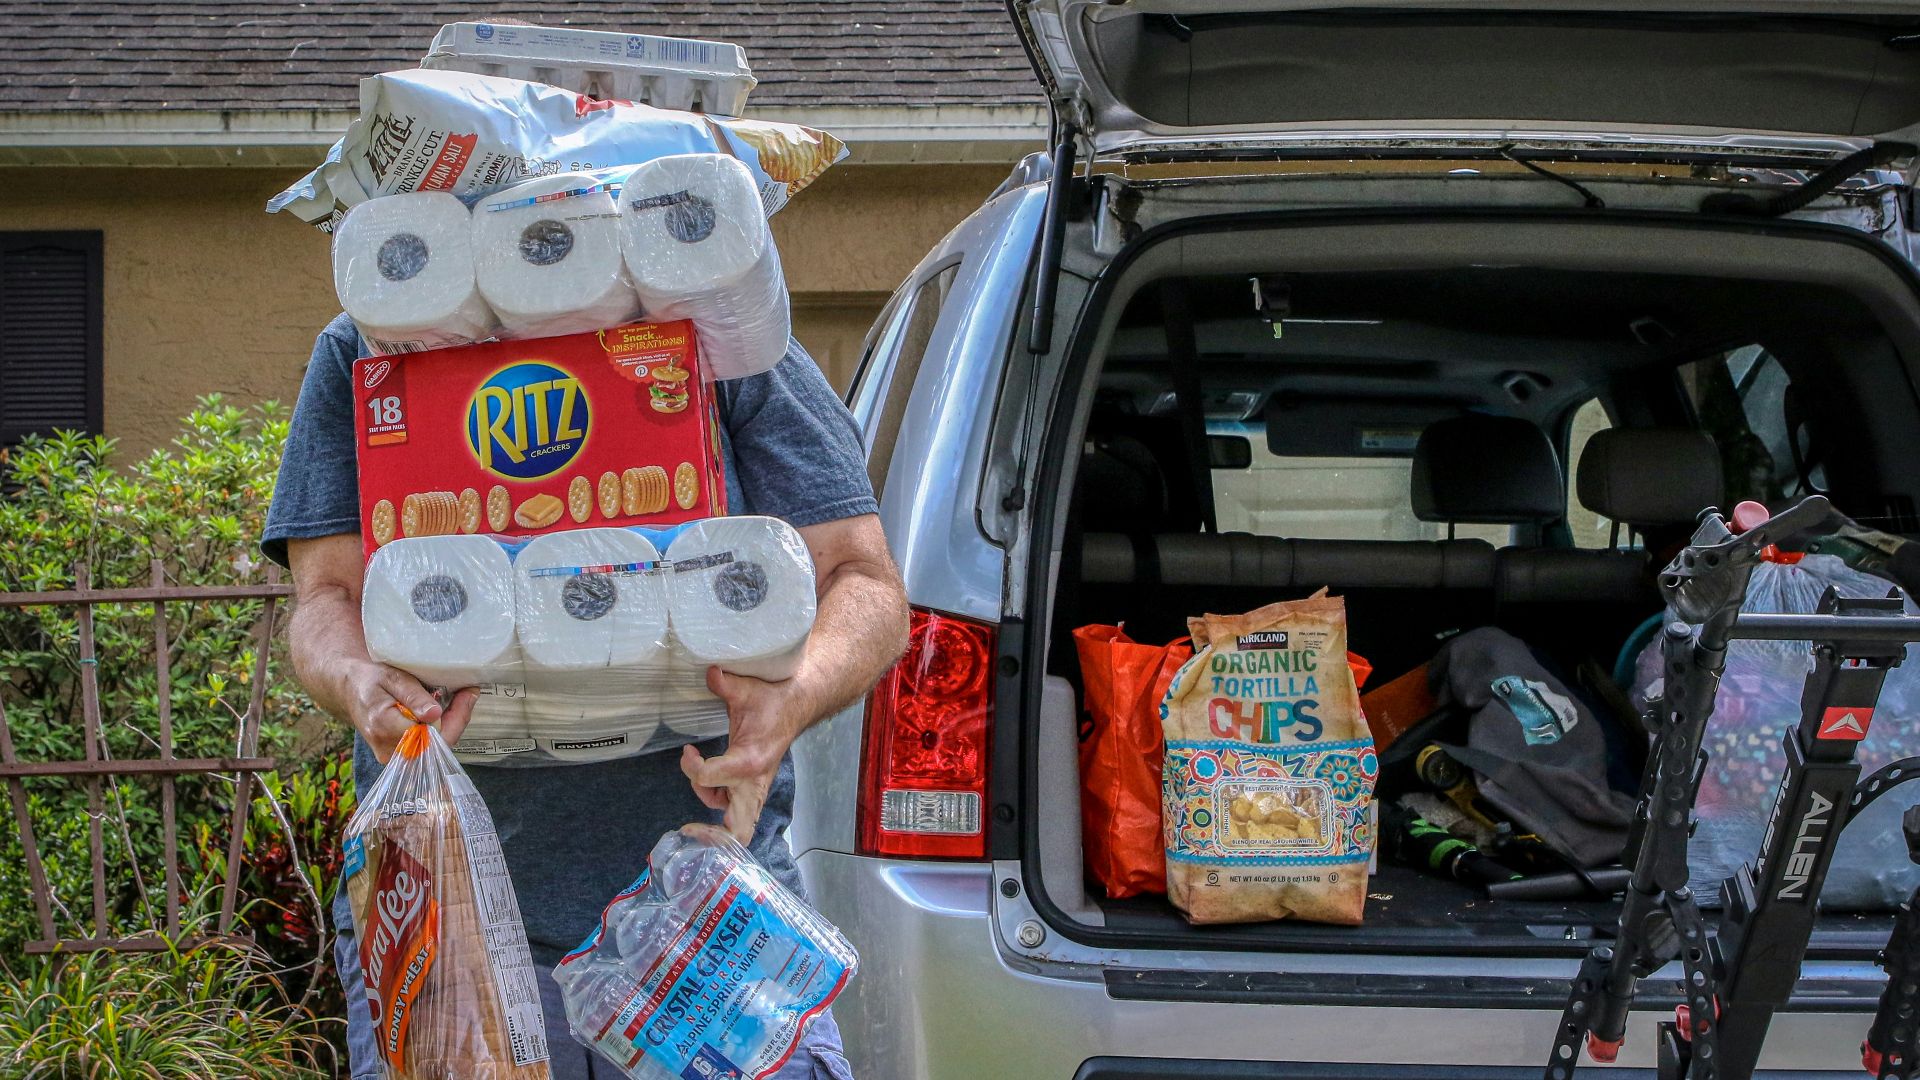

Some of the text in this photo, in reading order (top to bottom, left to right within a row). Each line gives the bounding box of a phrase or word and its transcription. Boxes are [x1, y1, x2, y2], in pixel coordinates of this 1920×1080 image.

[363, 112, 414, 190] KETTLE
[394, 149, 415, 176] BRAND
[442, 142, 463, 163] SALT
[483, 153, 507, 185] PROMISE
[612, 336, 685, 353] INSPIRATIONS!
[623, 331, 654, 343] Snack
[366, 363, 388, 386] NABISCO
[368, 396, 402, 424] 18
[475, 378, 582, 470] RITZ
[530, 443, 571, 458] CRACKERS
[1239, 633, 1287, 644] KIRKLAND
[1211, 650, 1317, 674] ORGANIC
[1211, 676, 1319, 698] TORTILLA
[1208, 698, 1323, 743] CHIPS
[557, 736, 622, 749] KIRKLAND
[1777, 790, 1833, 900] ALLEN
[362, 871, 424, 1029] Sara Lee
[644, 909, 723, 1016] BOTTLED AT THE SOURCE
[646, 905, 755, 1046] CRYSTAL GEYSER
[686, 951, 743, 1024] NATURAL
[388, 996, 407, 1052] HONEY
[399, 946, 429, 995] WHEAT
[676, 930, 771, 1060] ALPINE SPRING WATER
[618, 999, 640, 1026] CRYSTAL
[721, 1016, 729, 1024] BY
[726, 1005, 735, 1016] CG
[508, 1016, 521, 1062] Nutrition
[517, 1033, 527, 1060] Facts
[691, 1056, 713, 1076] 6
